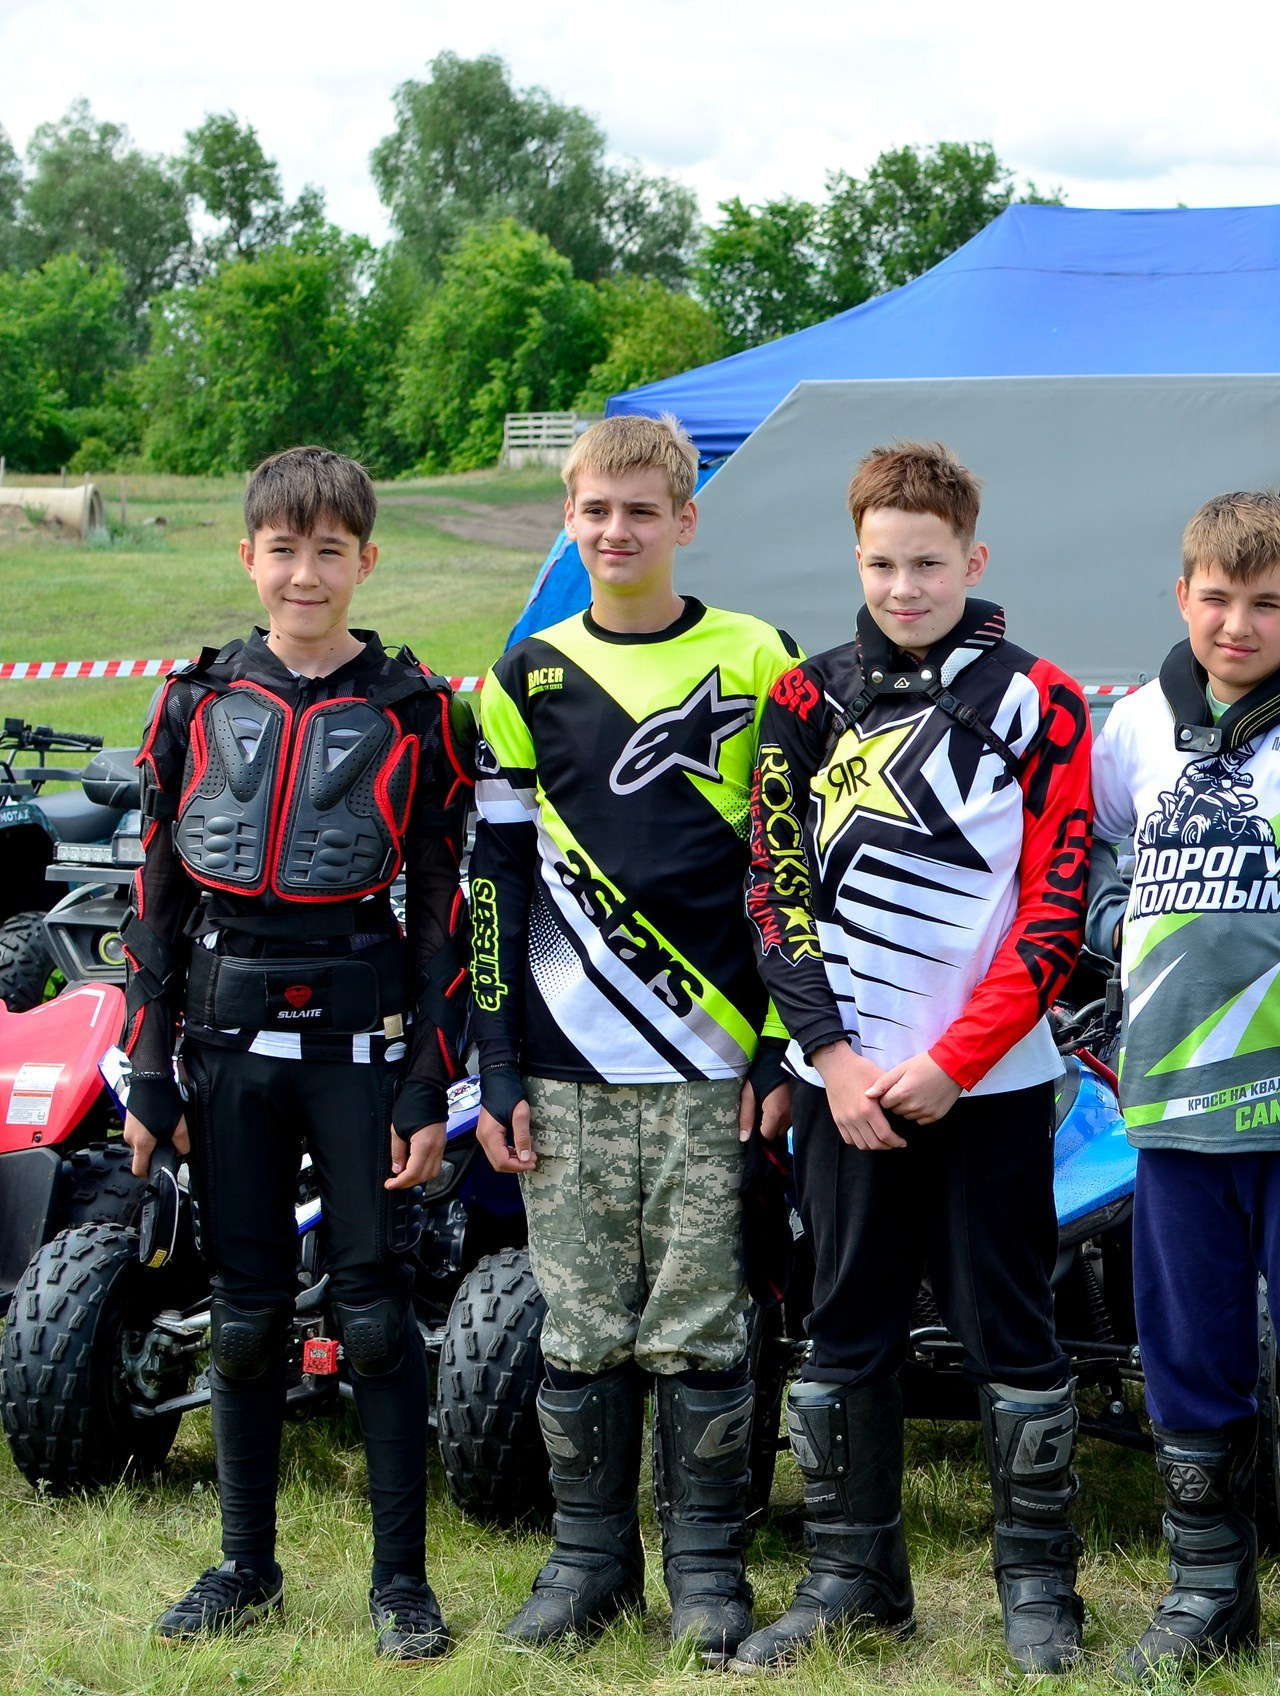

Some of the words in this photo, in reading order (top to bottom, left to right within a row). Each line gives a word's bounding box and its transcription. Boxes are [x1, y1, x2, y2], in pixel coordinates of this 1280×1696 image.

[527, 667, 564, 690] RACER
[748, 880, 783, 952] DRINK
[276, 1008, 323, 1019] SULAITE
[1188, 1092, 1227, 1112] КРОСС
[1230, 1087, 1248, 1101] НА
